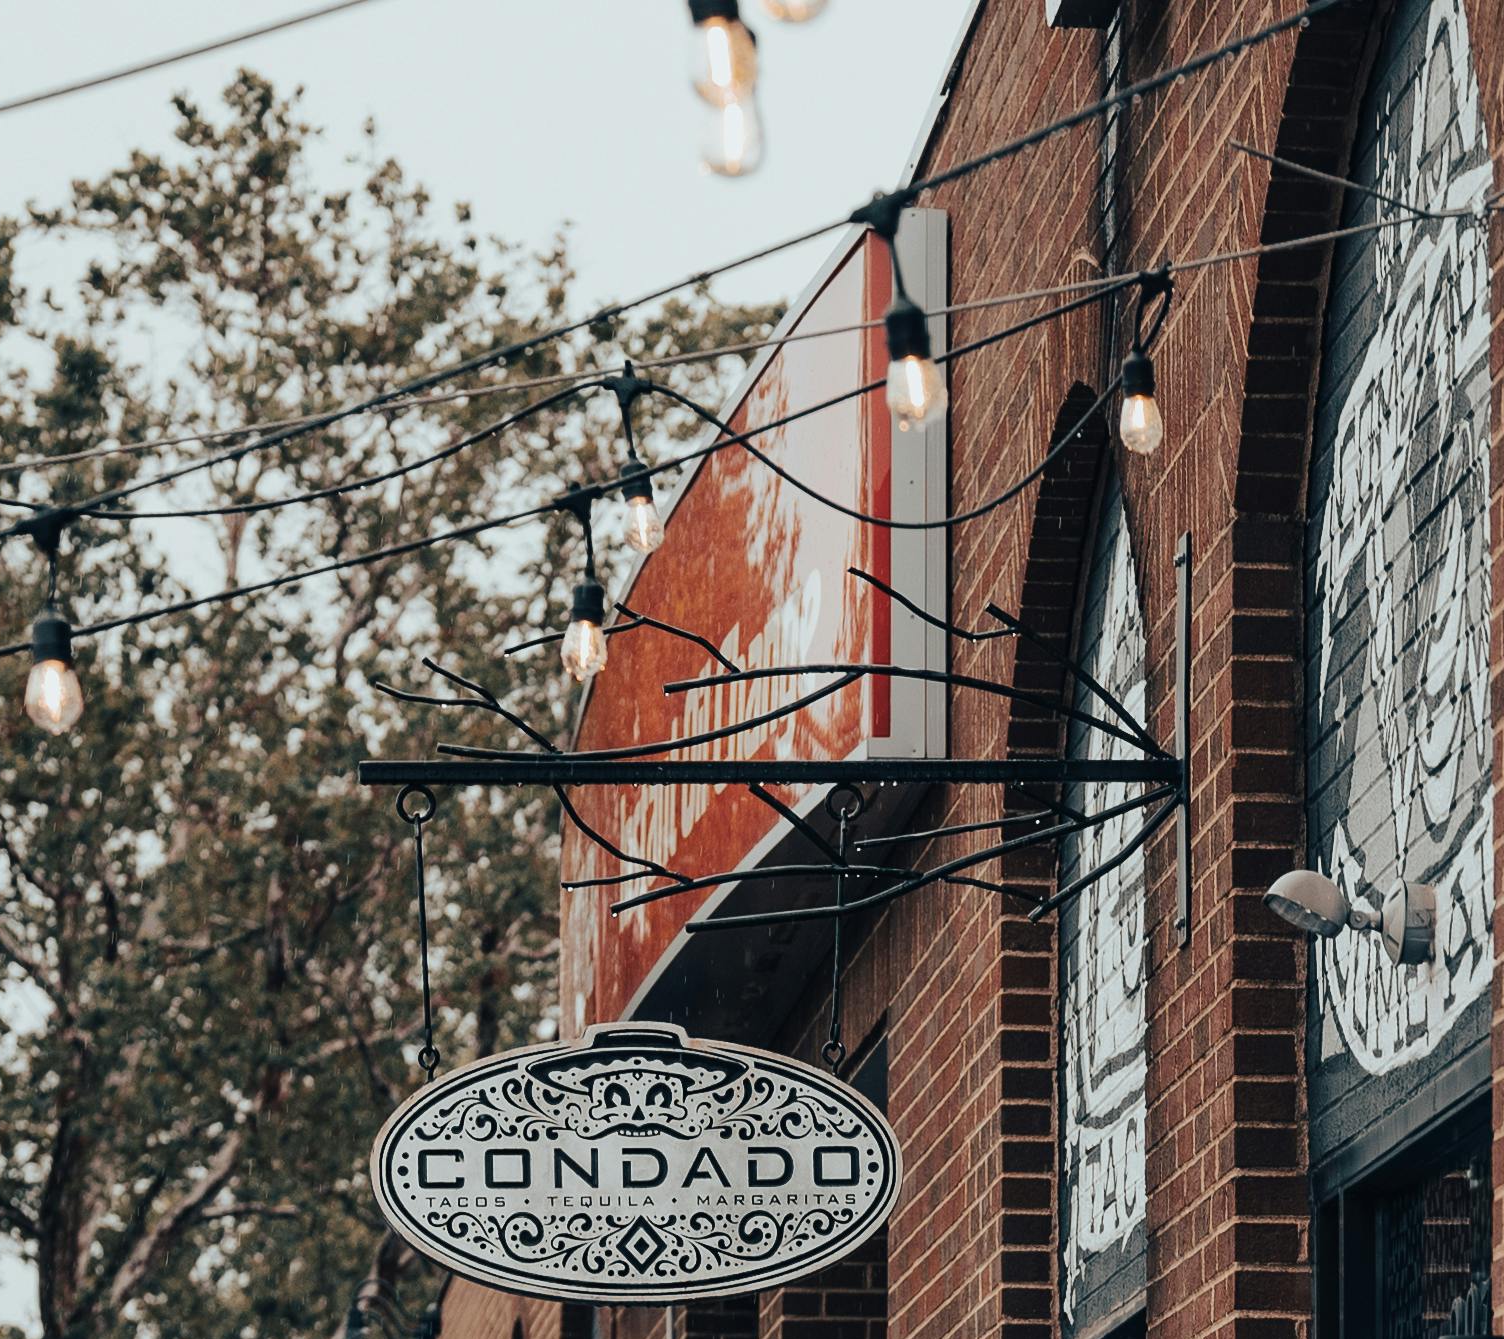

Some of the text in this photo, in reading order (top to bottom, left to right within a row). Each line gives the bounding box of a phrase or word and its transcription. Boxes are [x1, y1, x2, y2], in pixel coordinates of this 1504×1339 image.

[417, 1146, 860, 1190] CONDADO
[426, 1193, 857, 1208] TACOS TEQUILA MARGARITAS
